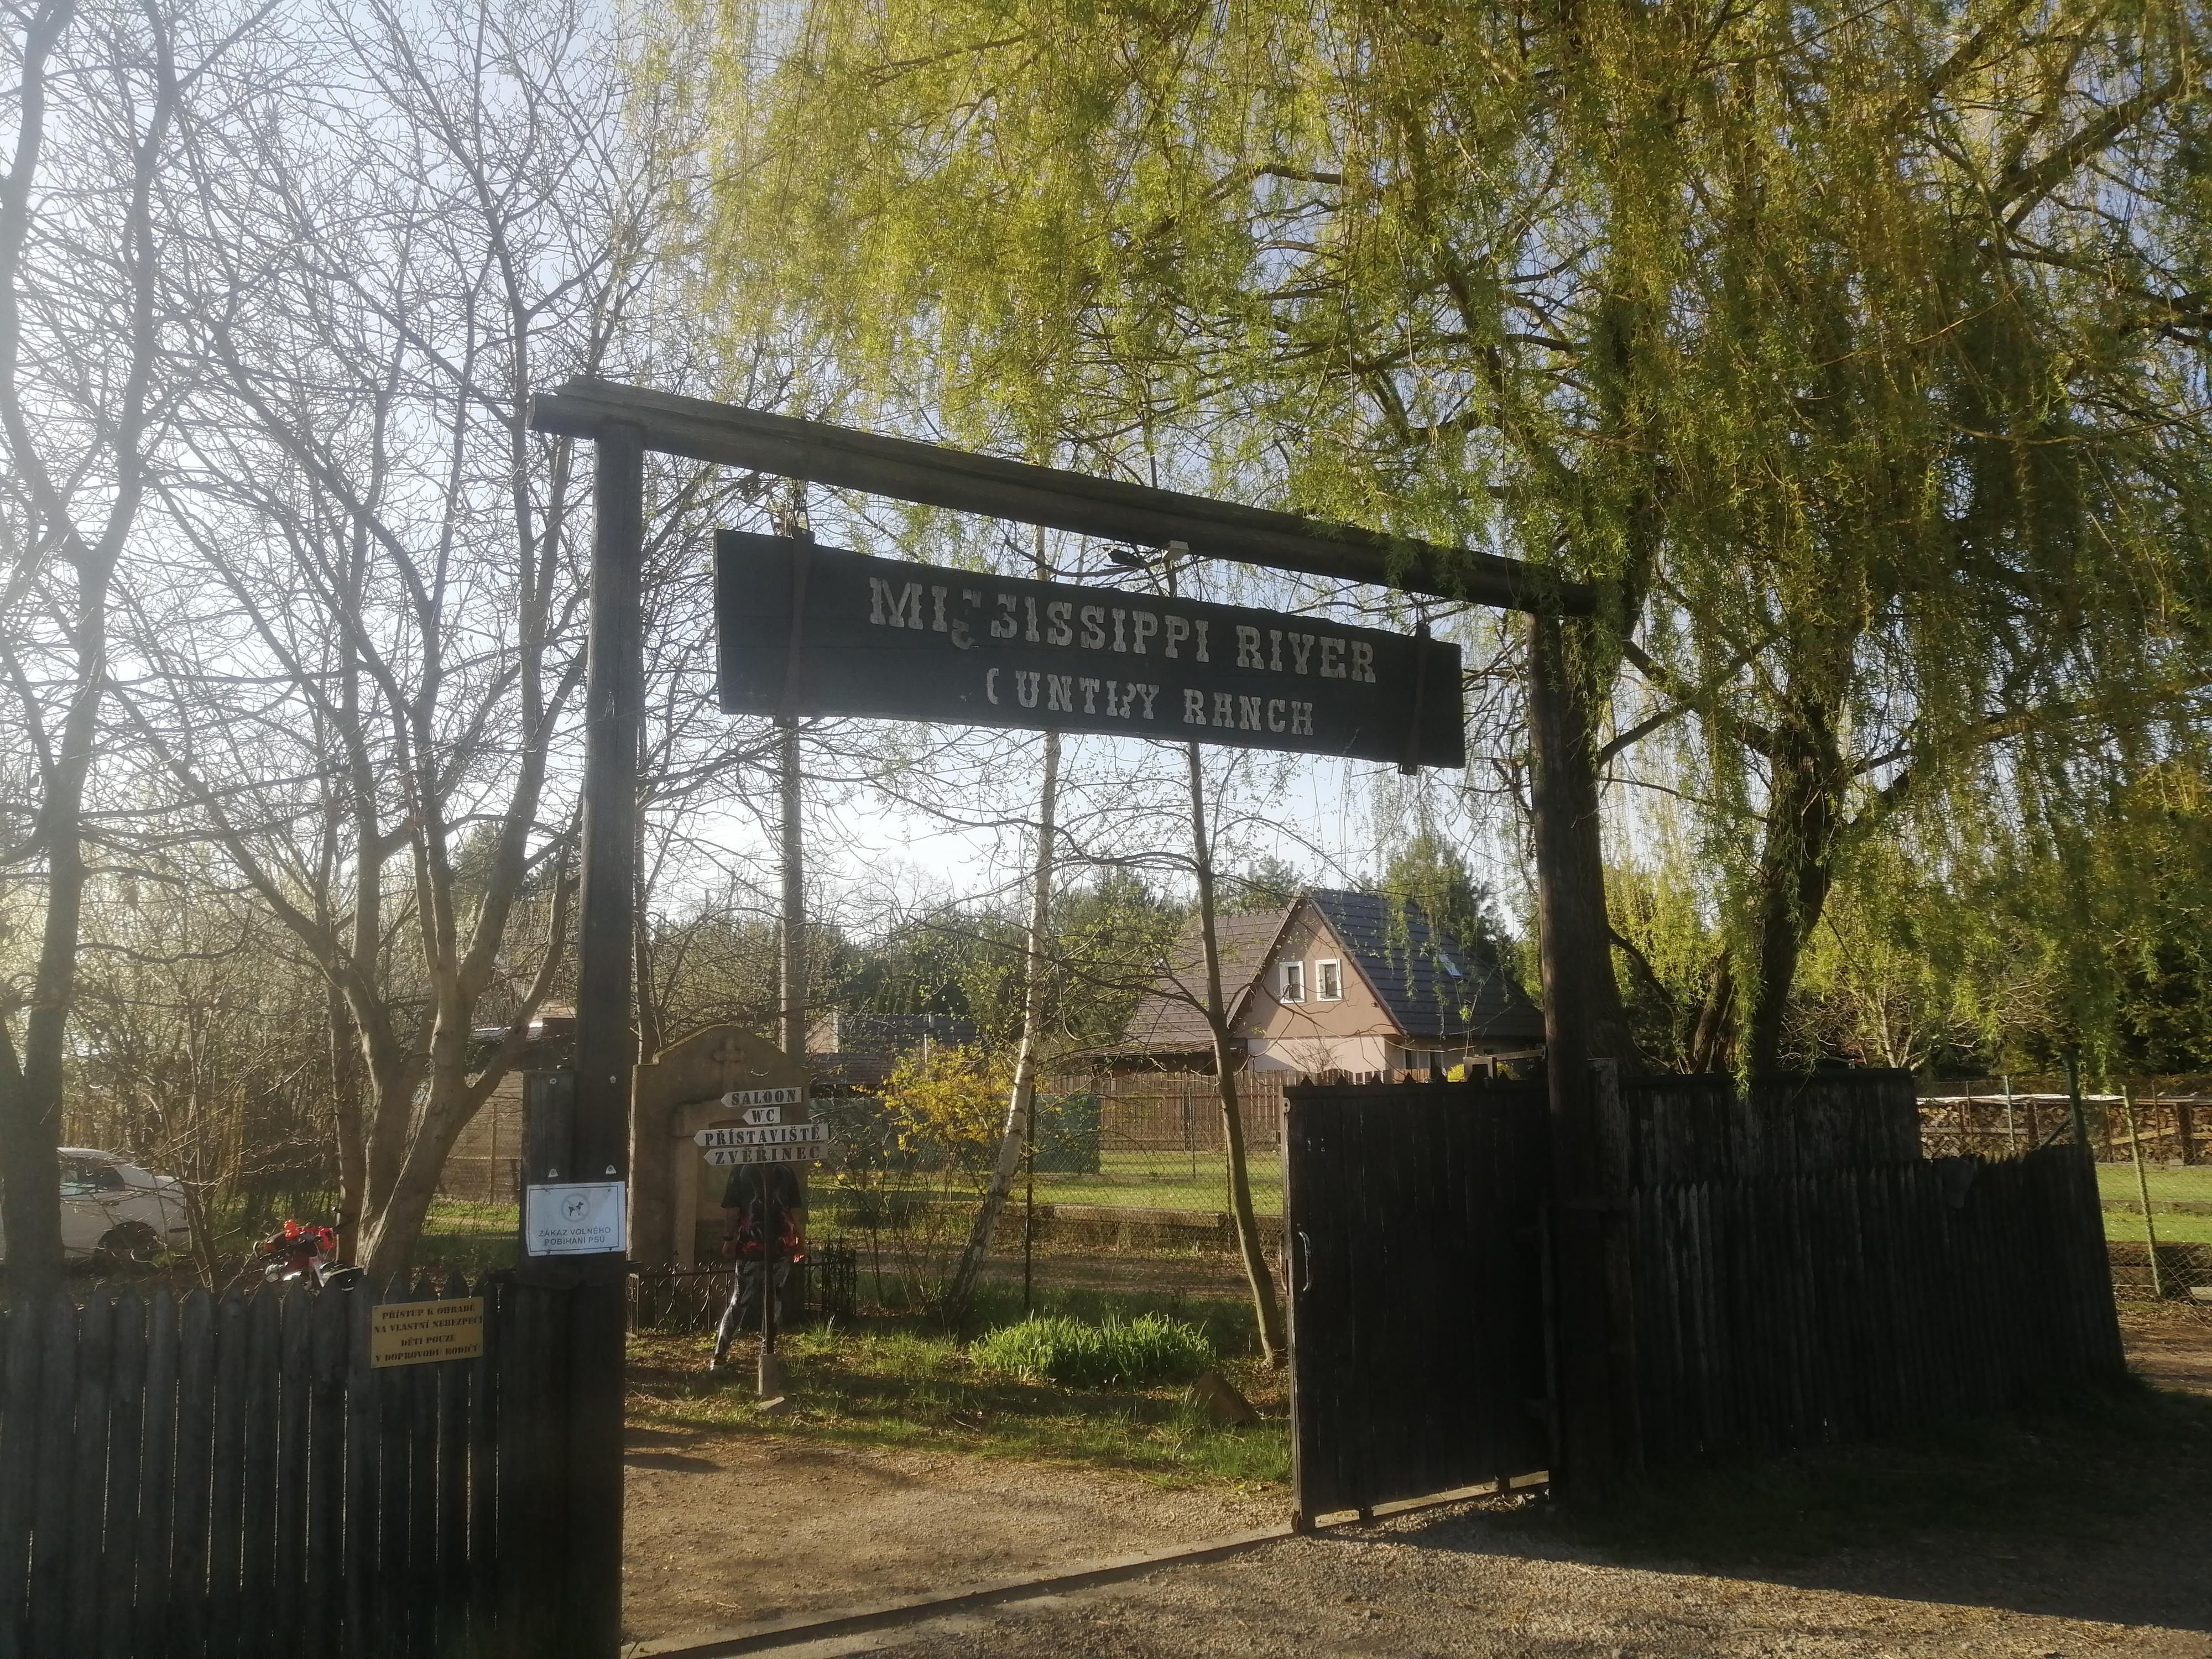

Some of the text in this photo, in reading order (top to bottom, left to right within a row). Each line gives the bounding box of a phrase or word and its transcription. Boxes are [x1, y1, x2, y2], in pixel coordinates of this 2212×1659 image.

[1236, 624, 1376, 684] RIVER
[1183, 688, 1314, 736] RANCH
[731, 1088, 797, 1106] SALOON
[752, 1109, 775, 1123] WC
[705, 1124, 820, 1146] PŘÍSTAVIŠTĚ
[715, 1145, 820, 1165] ZVĚŘINEC
[570, 1225, 611, 1235] VOLNÉHO
[426, 1334, 456, 1344] POUZE
